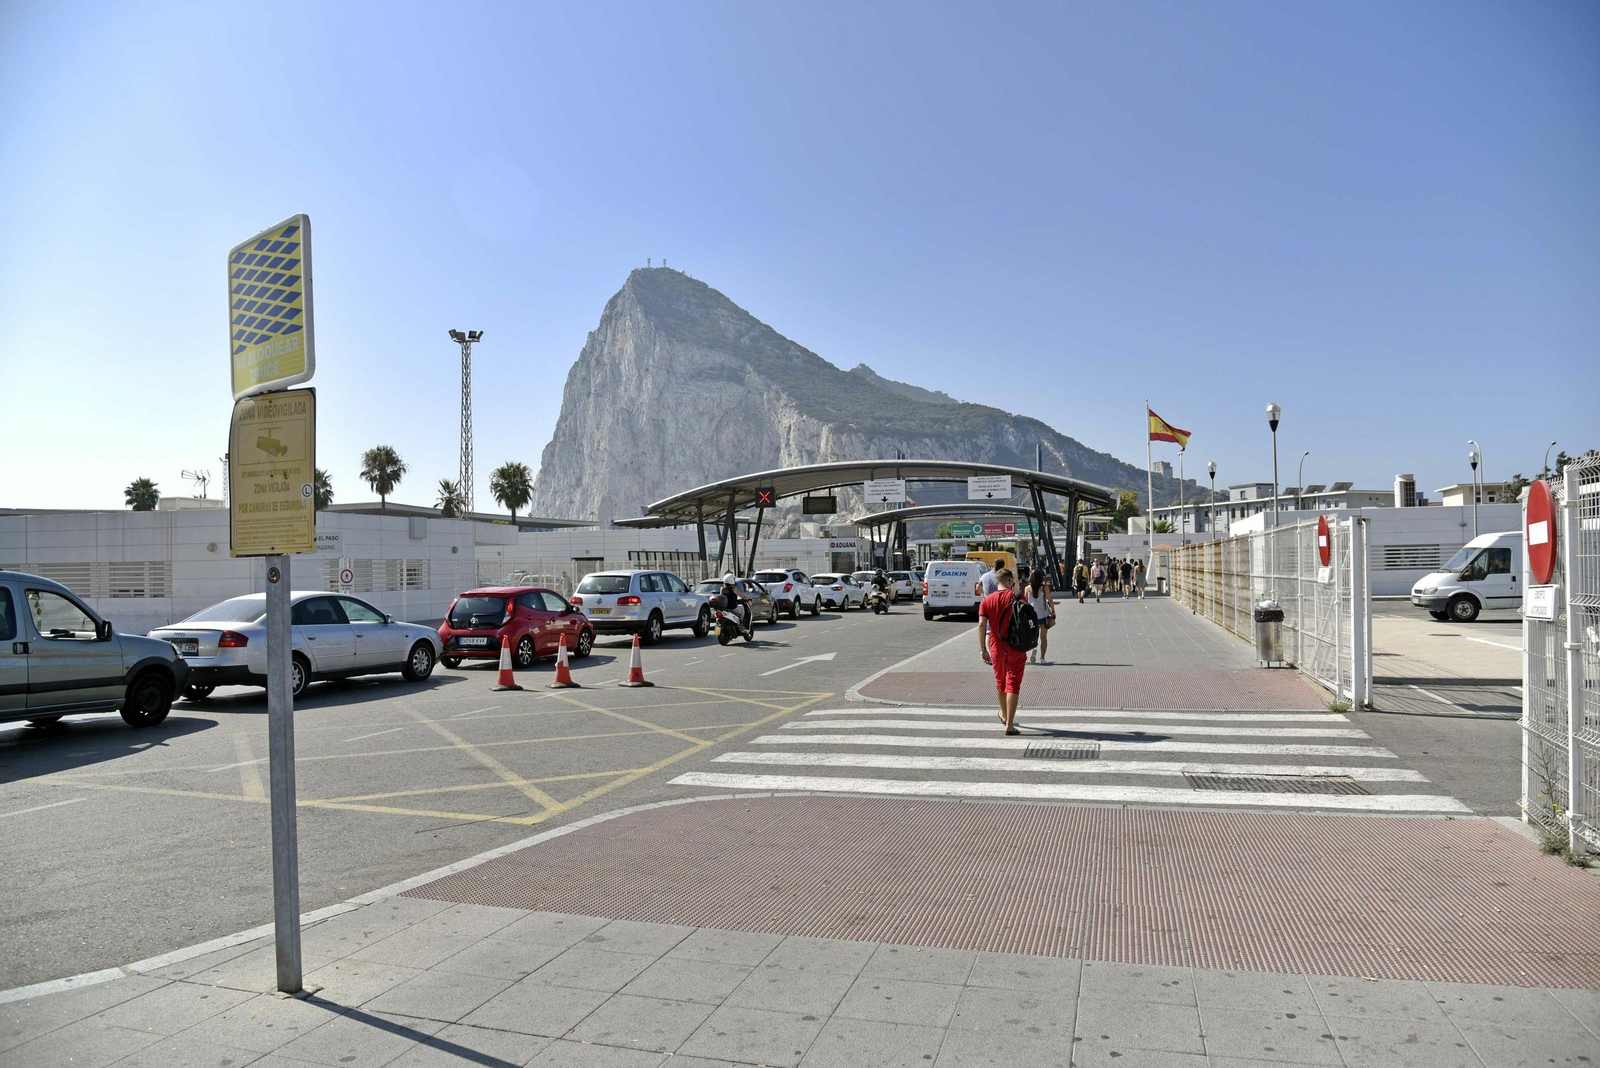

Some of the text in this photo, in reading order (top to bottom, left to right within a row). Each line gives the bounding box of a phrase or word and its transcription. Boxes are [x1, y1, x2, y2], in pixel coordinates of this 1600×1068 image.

[236, 336, 299, 371] NO BLOQUEAR
[250, 360, 280, 383] CRUCE
[240, 401, 306, 420] ZONA VIDEOVIGILADA
[254, 482, 290, 494] ZONA VIGILADA
[239, 503, 248, 513] POR
[272, 501, 278, 511] DE
